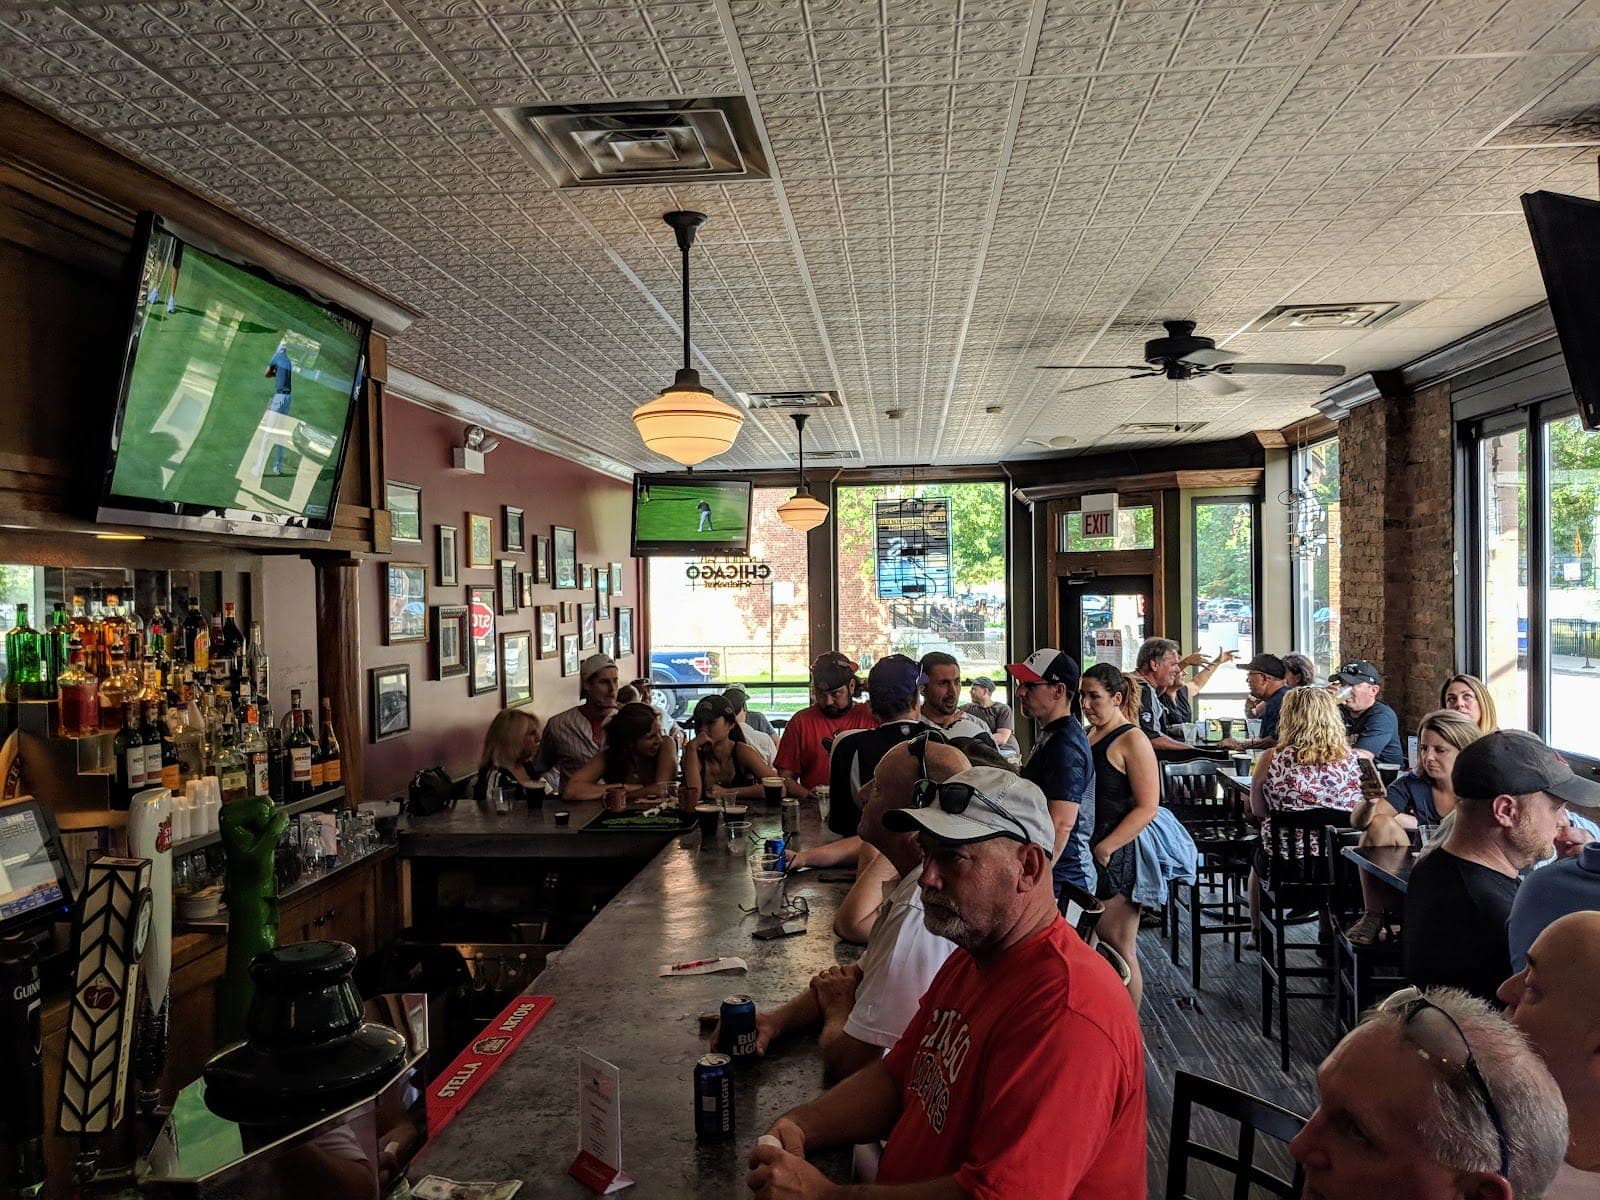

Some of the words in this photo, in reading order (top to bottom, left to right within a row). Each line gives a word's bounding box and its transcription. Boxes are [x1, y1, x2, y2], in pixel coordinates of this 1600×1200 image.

[1085, 513, 1110, 535] EXIT
[732, 1042, 757, 1056] LIG
[737, 1030, 757, 1046] BU
[437, 1062, 483, 1098] STELLA
[498, 1003, 536, 1032] ARTOIS
[721, 1077, 731, 1107] LIGHT
[721, 1108, 731, 1132] BUD
